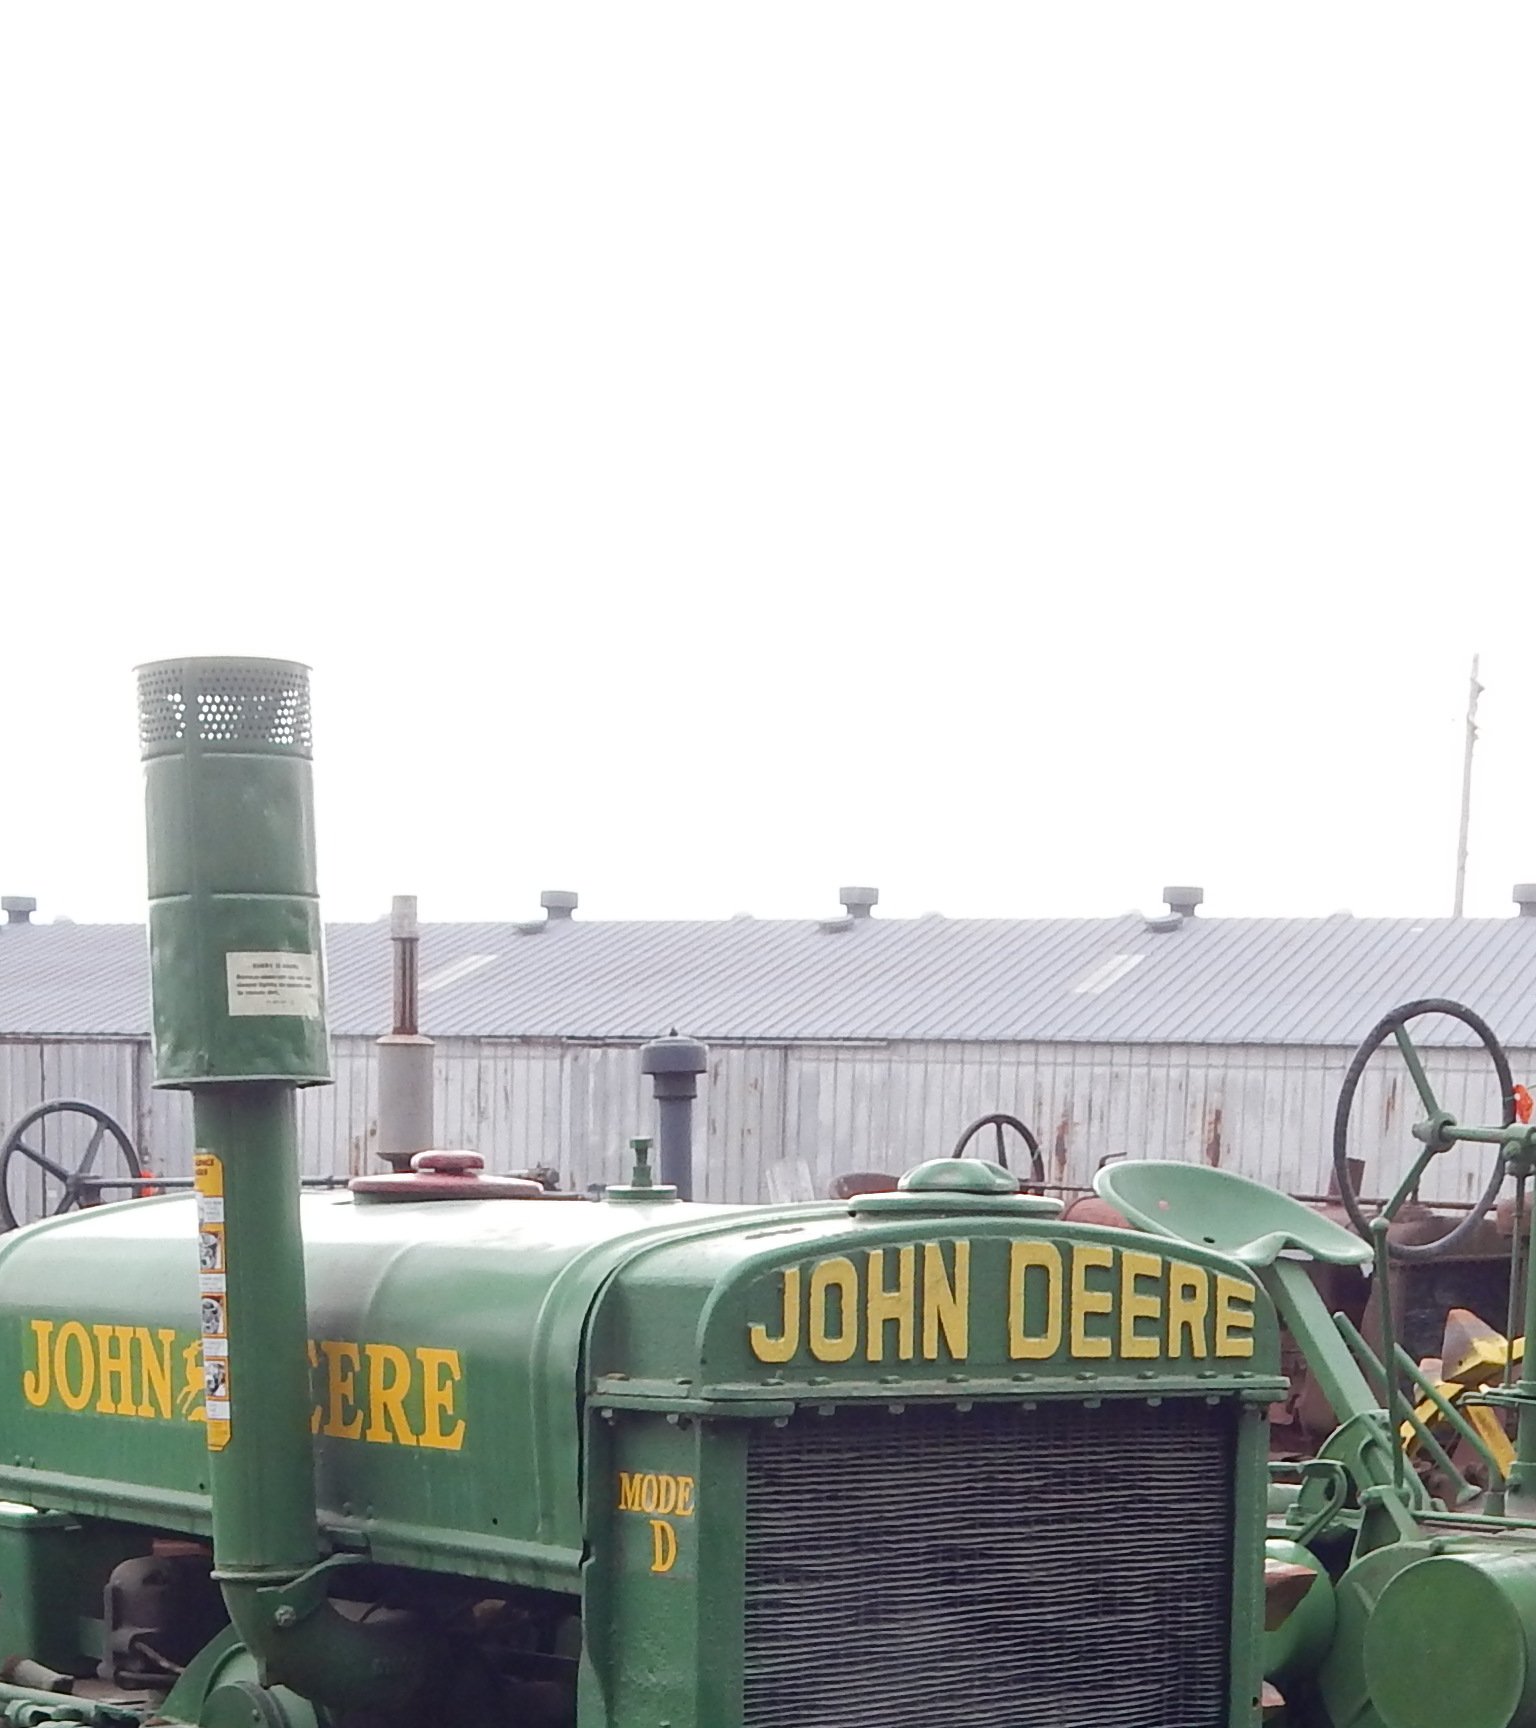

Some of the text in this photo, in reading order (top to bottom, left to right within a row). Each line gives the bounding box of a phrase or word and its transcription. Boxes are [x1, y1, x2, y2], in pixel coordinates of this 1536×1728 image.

[749, 1238, 1257, 1363] JOHN DEERE
[22, 1319, 466, 1451] JOHN ERE
[648, 1519, 677, 1572] D
